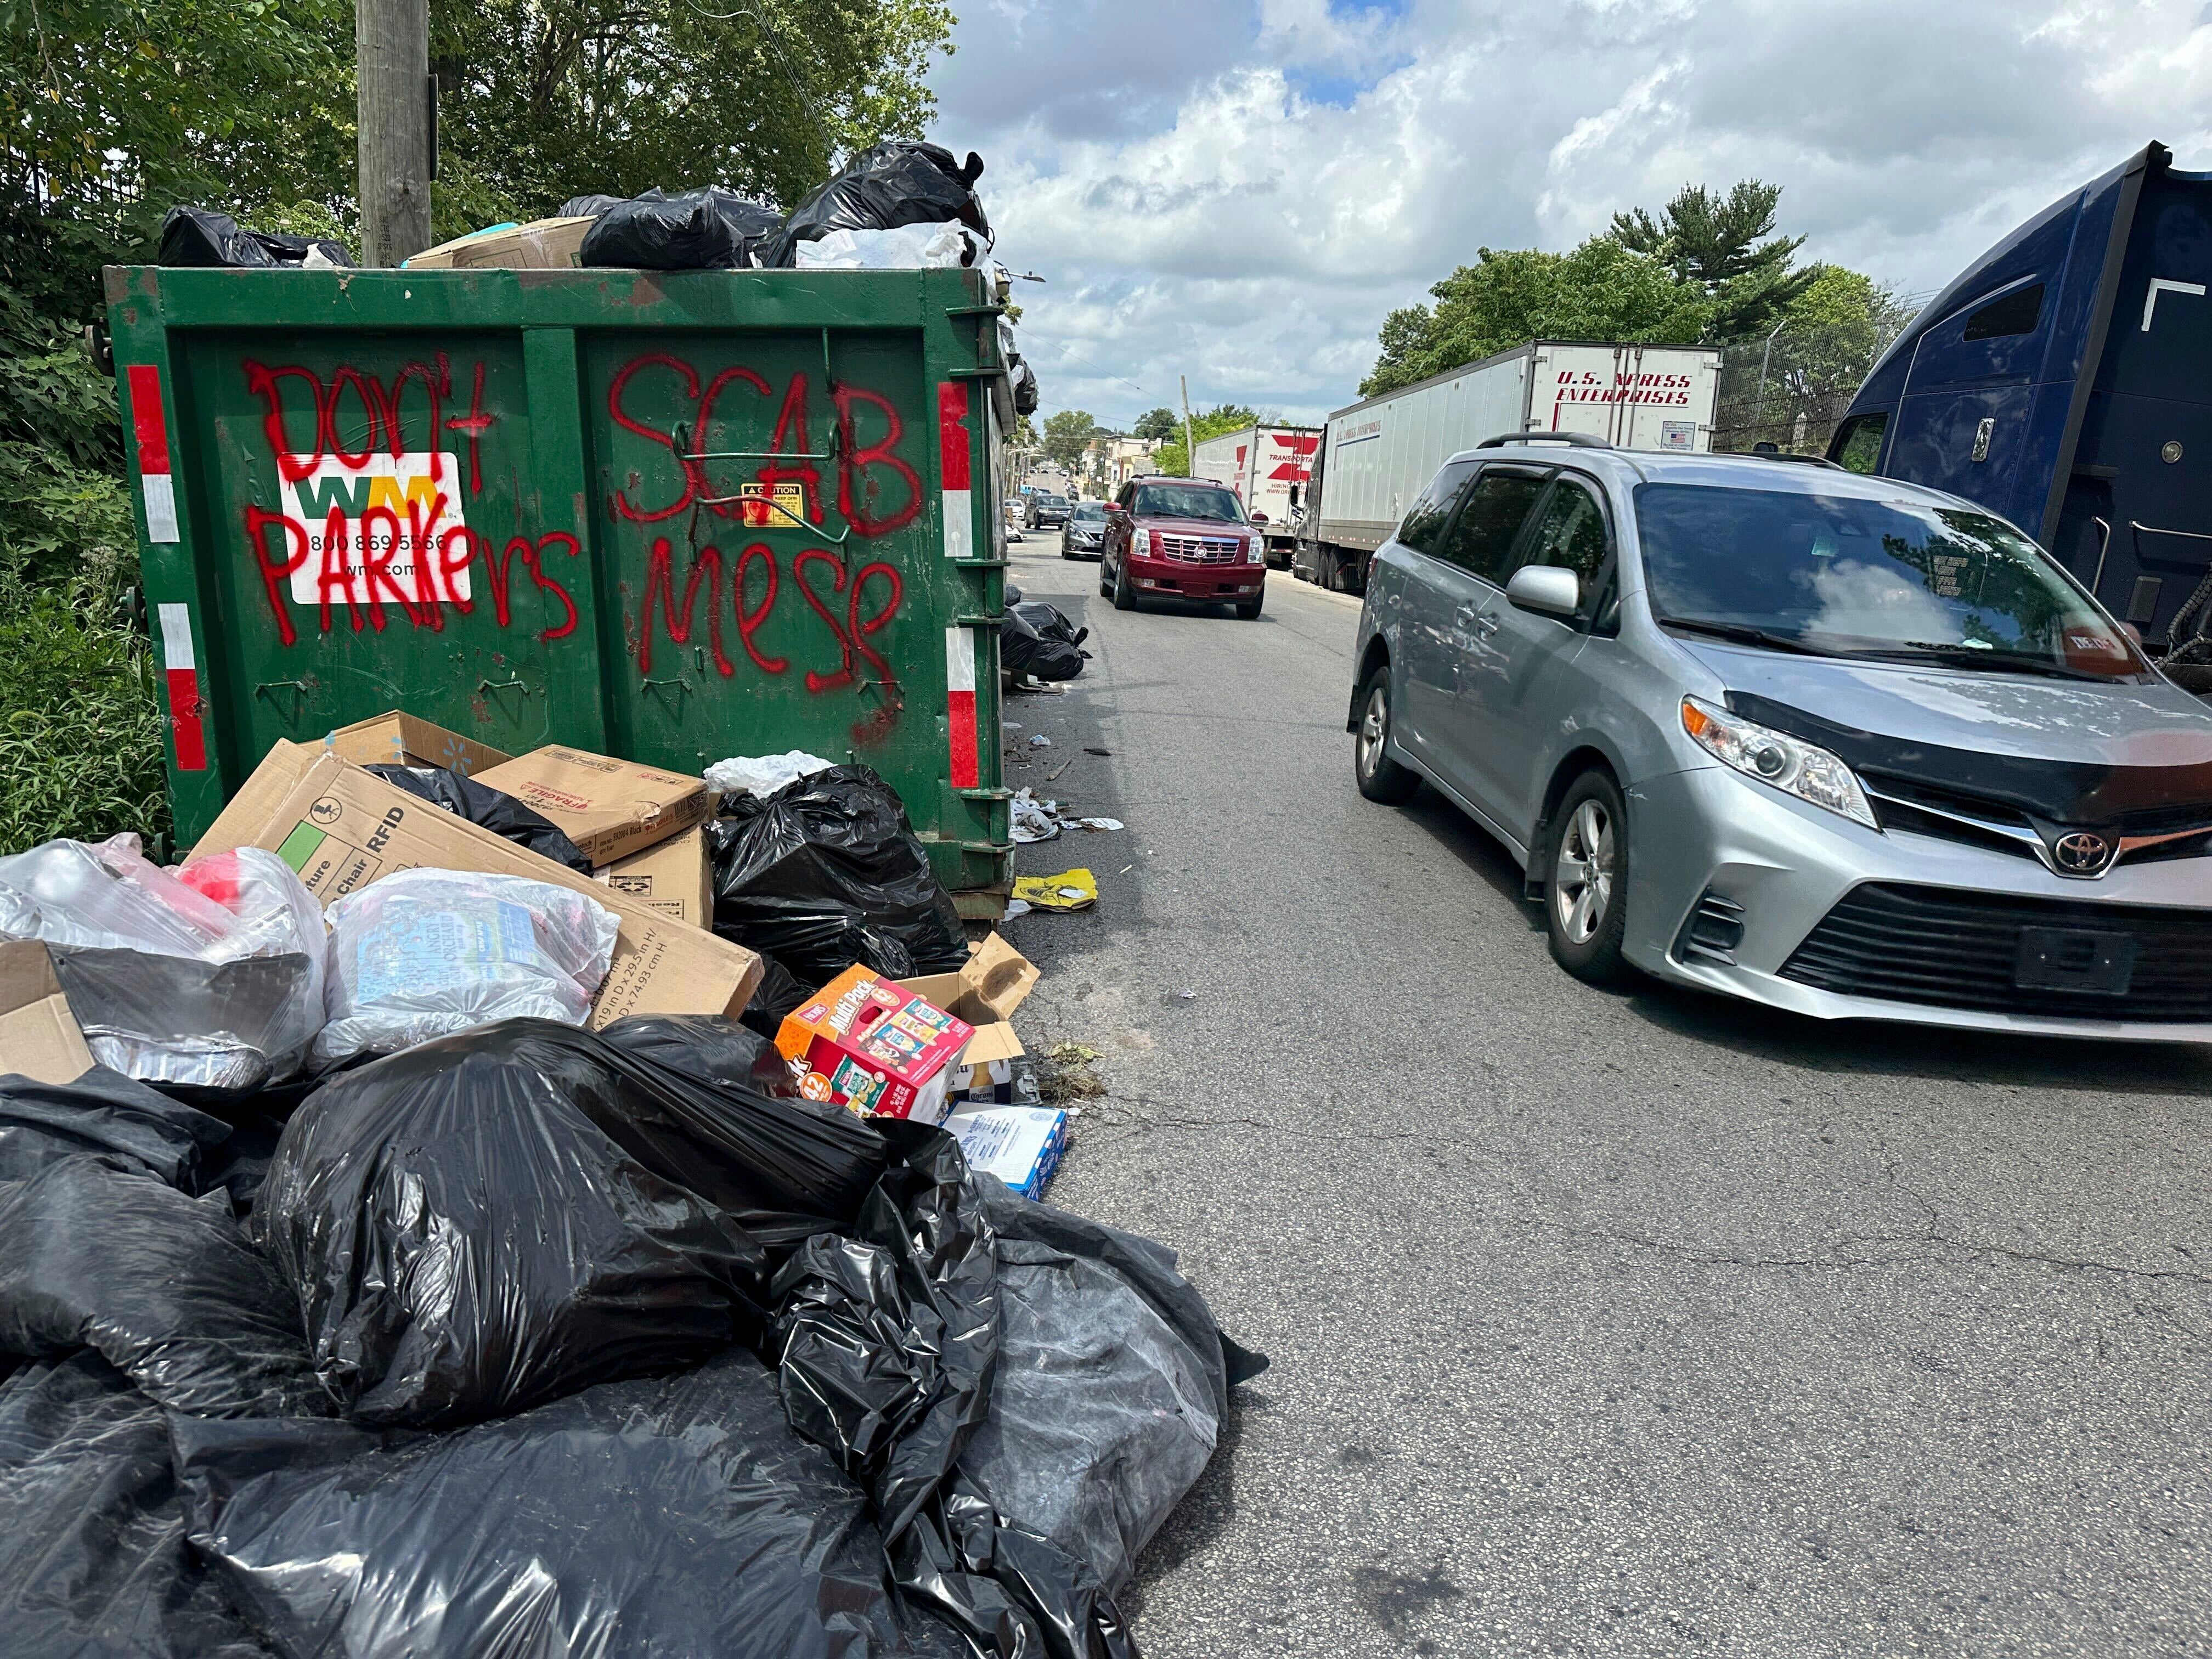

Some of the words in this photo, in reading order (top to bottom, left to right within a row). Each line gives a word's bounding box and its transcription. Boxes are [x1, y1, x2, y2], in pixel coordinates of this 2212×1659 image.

[1557, 371, 1602, 385] U.S.
[1616, 373, 1692, 388] XPRESS
[1556, 388, 1690, 404] ENTERPRISES
[608, 353, 923, 536] SCAB
[291, 476, 447, 519] WM
[311, 535, 348, 551] 800
[356, 535, 392, 551] 869
[399, 535, 447, 550] 5566
[343, 565, 418, 576] wmcom
[527, 788, 579, 808] FRAGILE
[366, 807, 404, 853] RFID
[629, 825, 642, 836] Black
[337, 859, 367, 895] Chair
[606, 997, 619, 1007] in
[613, 985, 624, 995] D
[624, 953, 642, 977] 29.5
[636, 943, 650, 954] in
[644, 927, 657, 942] H/
[619, 1008, 629, 1016] D
[629, 970, 651, 998] 74.93
[649, 953, 662, 969] cm
[656, 943, 667, 952] H
[828, 998, 856, 1035] Multi
[843, 979, 876, 1006] Pack
[803, 1076, 824, 1101] 42
[971, 1092, 993, 1101] Corona
